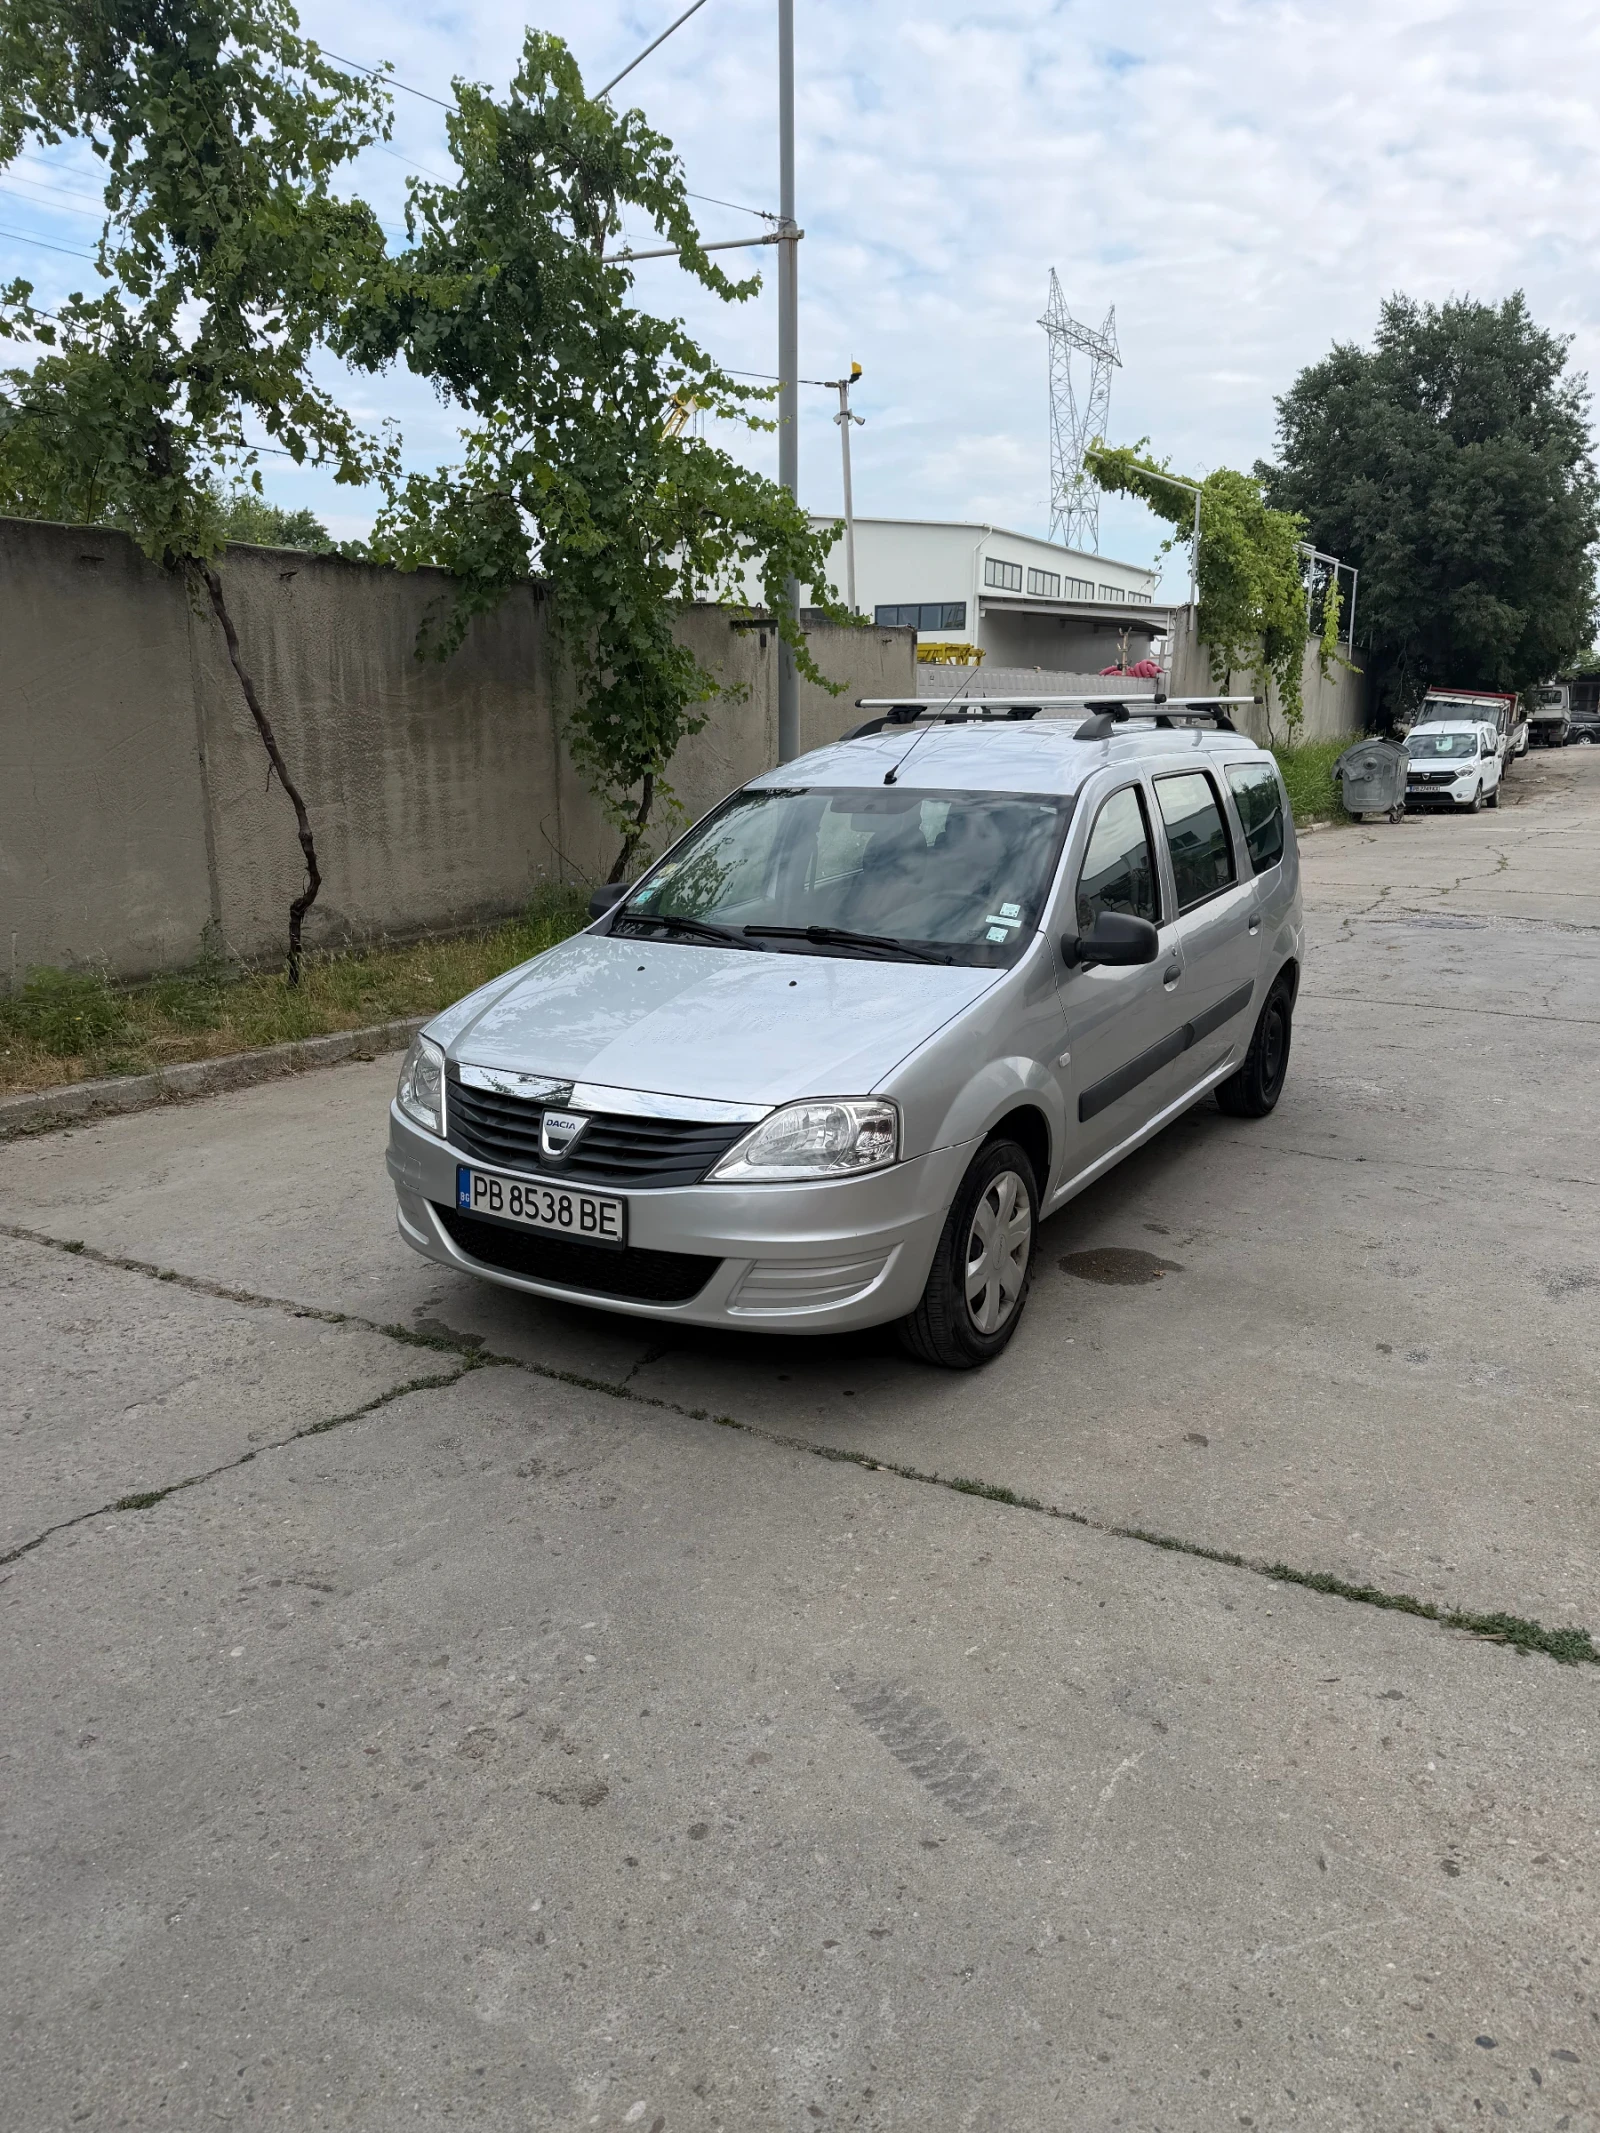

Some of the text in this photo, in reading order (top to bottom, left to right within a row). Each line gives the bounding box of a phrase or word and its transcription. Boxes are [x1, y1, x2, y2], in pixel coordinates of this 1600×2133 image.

[546, 1119, 576, 1130] DACIA
[460, 1191, 470, 1202] BG
[474, 1175, 617, 1236] PB 8538 BE
